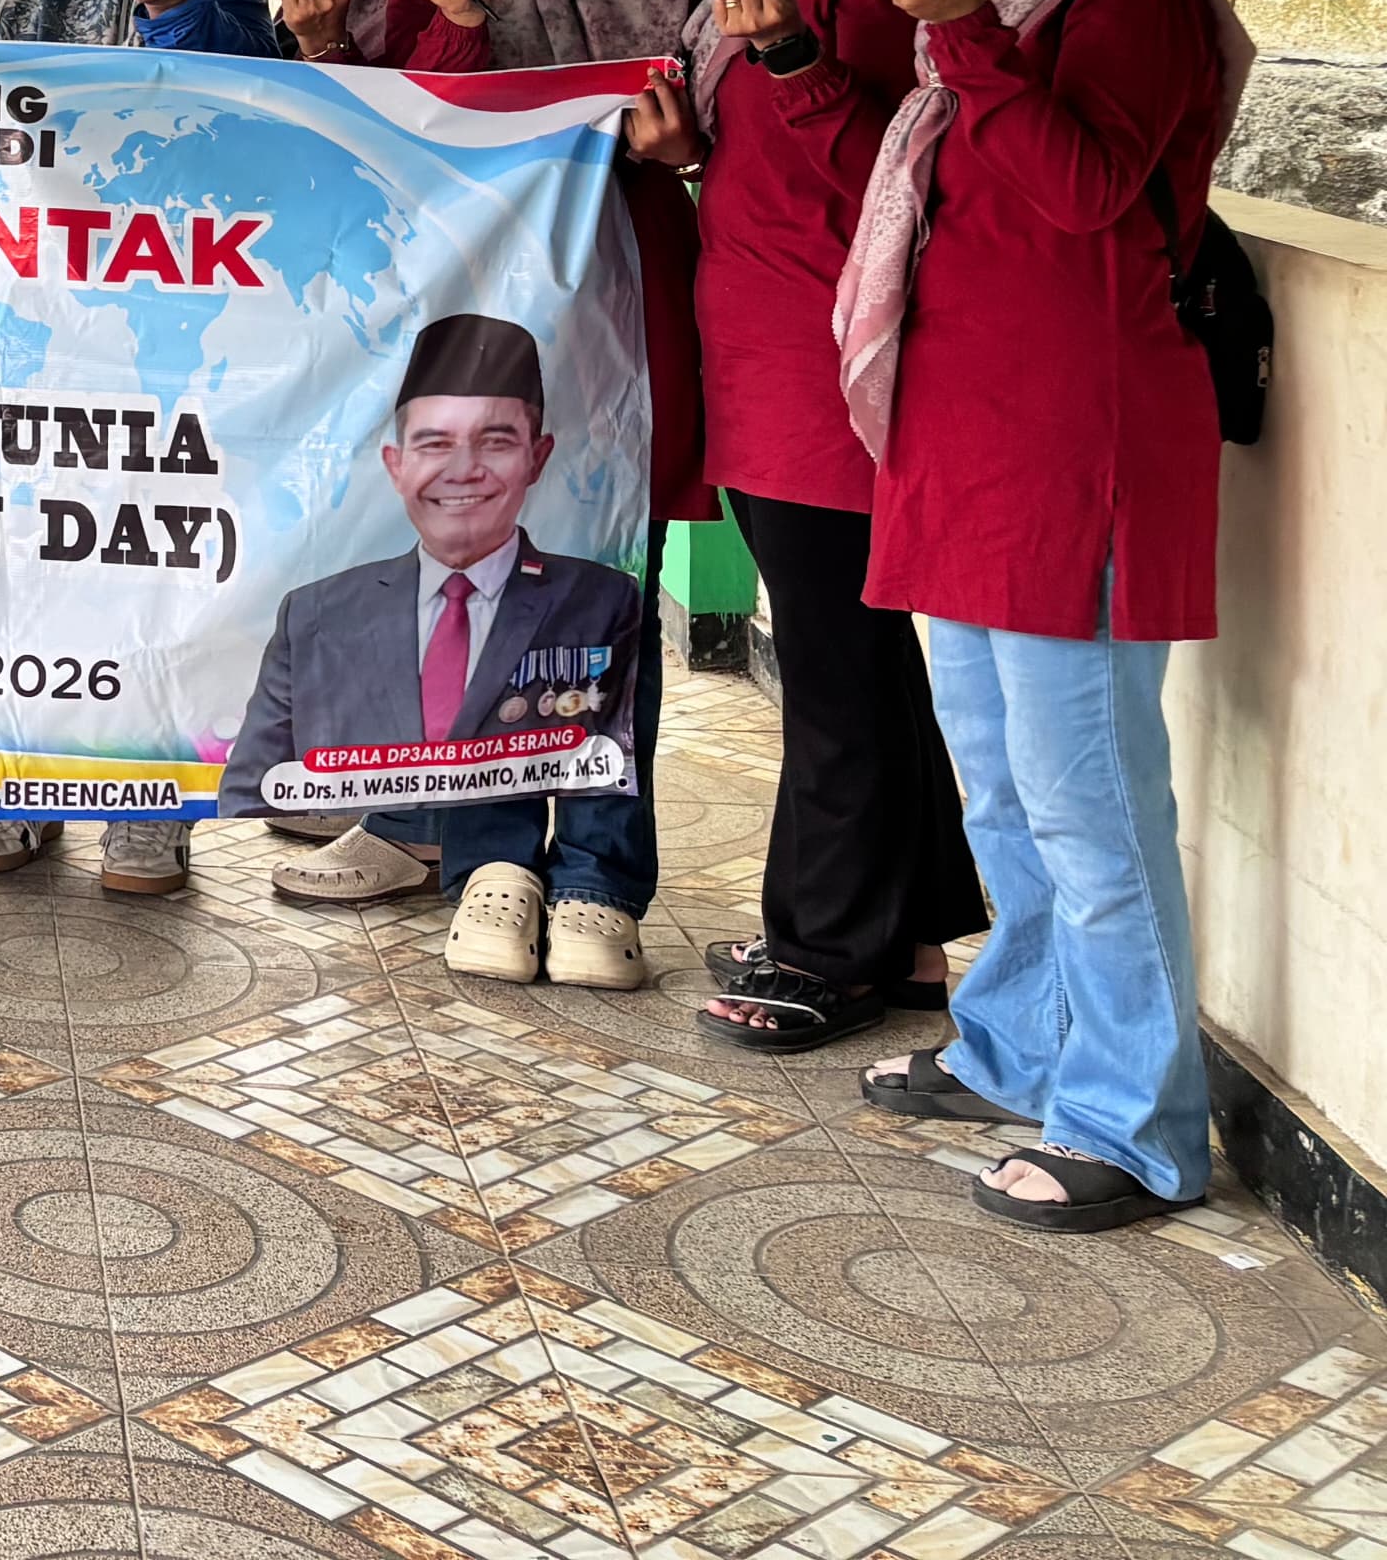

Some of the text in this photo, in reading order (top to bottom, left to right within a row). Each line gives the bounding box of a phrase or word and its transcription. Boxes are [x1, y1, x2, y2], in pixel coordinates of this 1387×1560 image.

[39, 499, 238, 583] DAY)
[314, 728, 575, 768] KEPALA DP3AKB KOTA SERANG
[4, 780, 179, 807] BERENCANA
[273, 755, 611, 801] Dr. Drs. H. WASIS DEWANTO, M.Pd., M.Si
